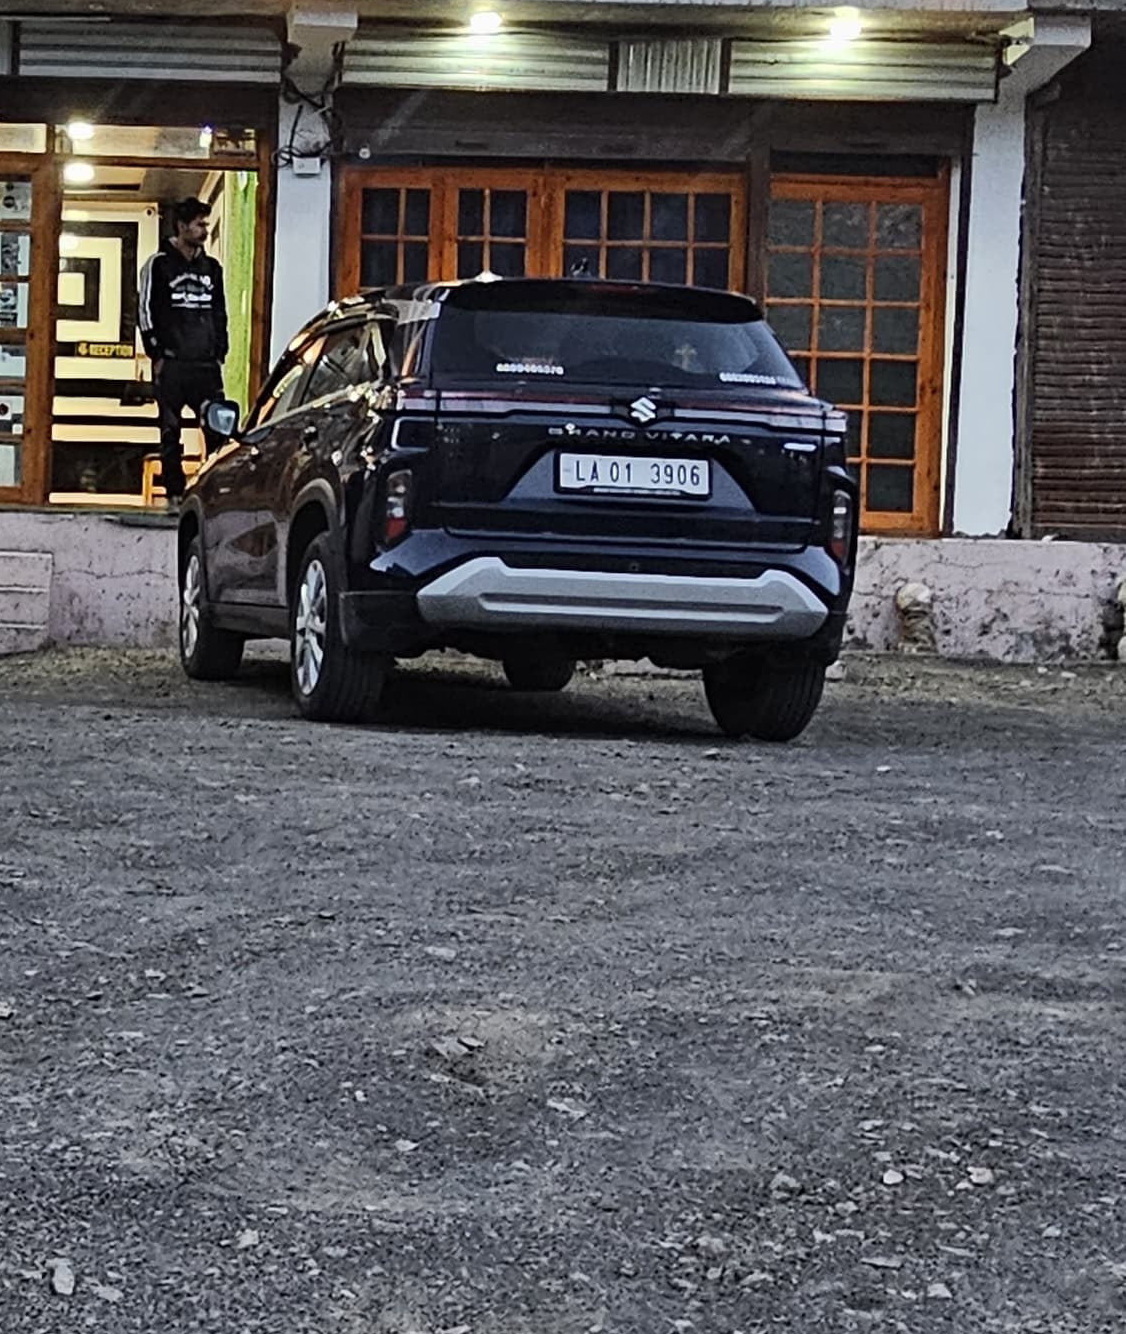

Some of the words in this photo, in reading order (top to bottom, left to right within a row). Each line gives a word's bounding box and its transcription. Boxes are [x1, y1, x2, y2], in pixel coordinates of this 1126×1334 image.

[548, 426, 635, 439] GRAND
[645, 431, 730, 444] VITARA
[576, 460, 599, 482] LA
[610, 461, 631, 483] 01
[650, 463, 700, 486] 3906
